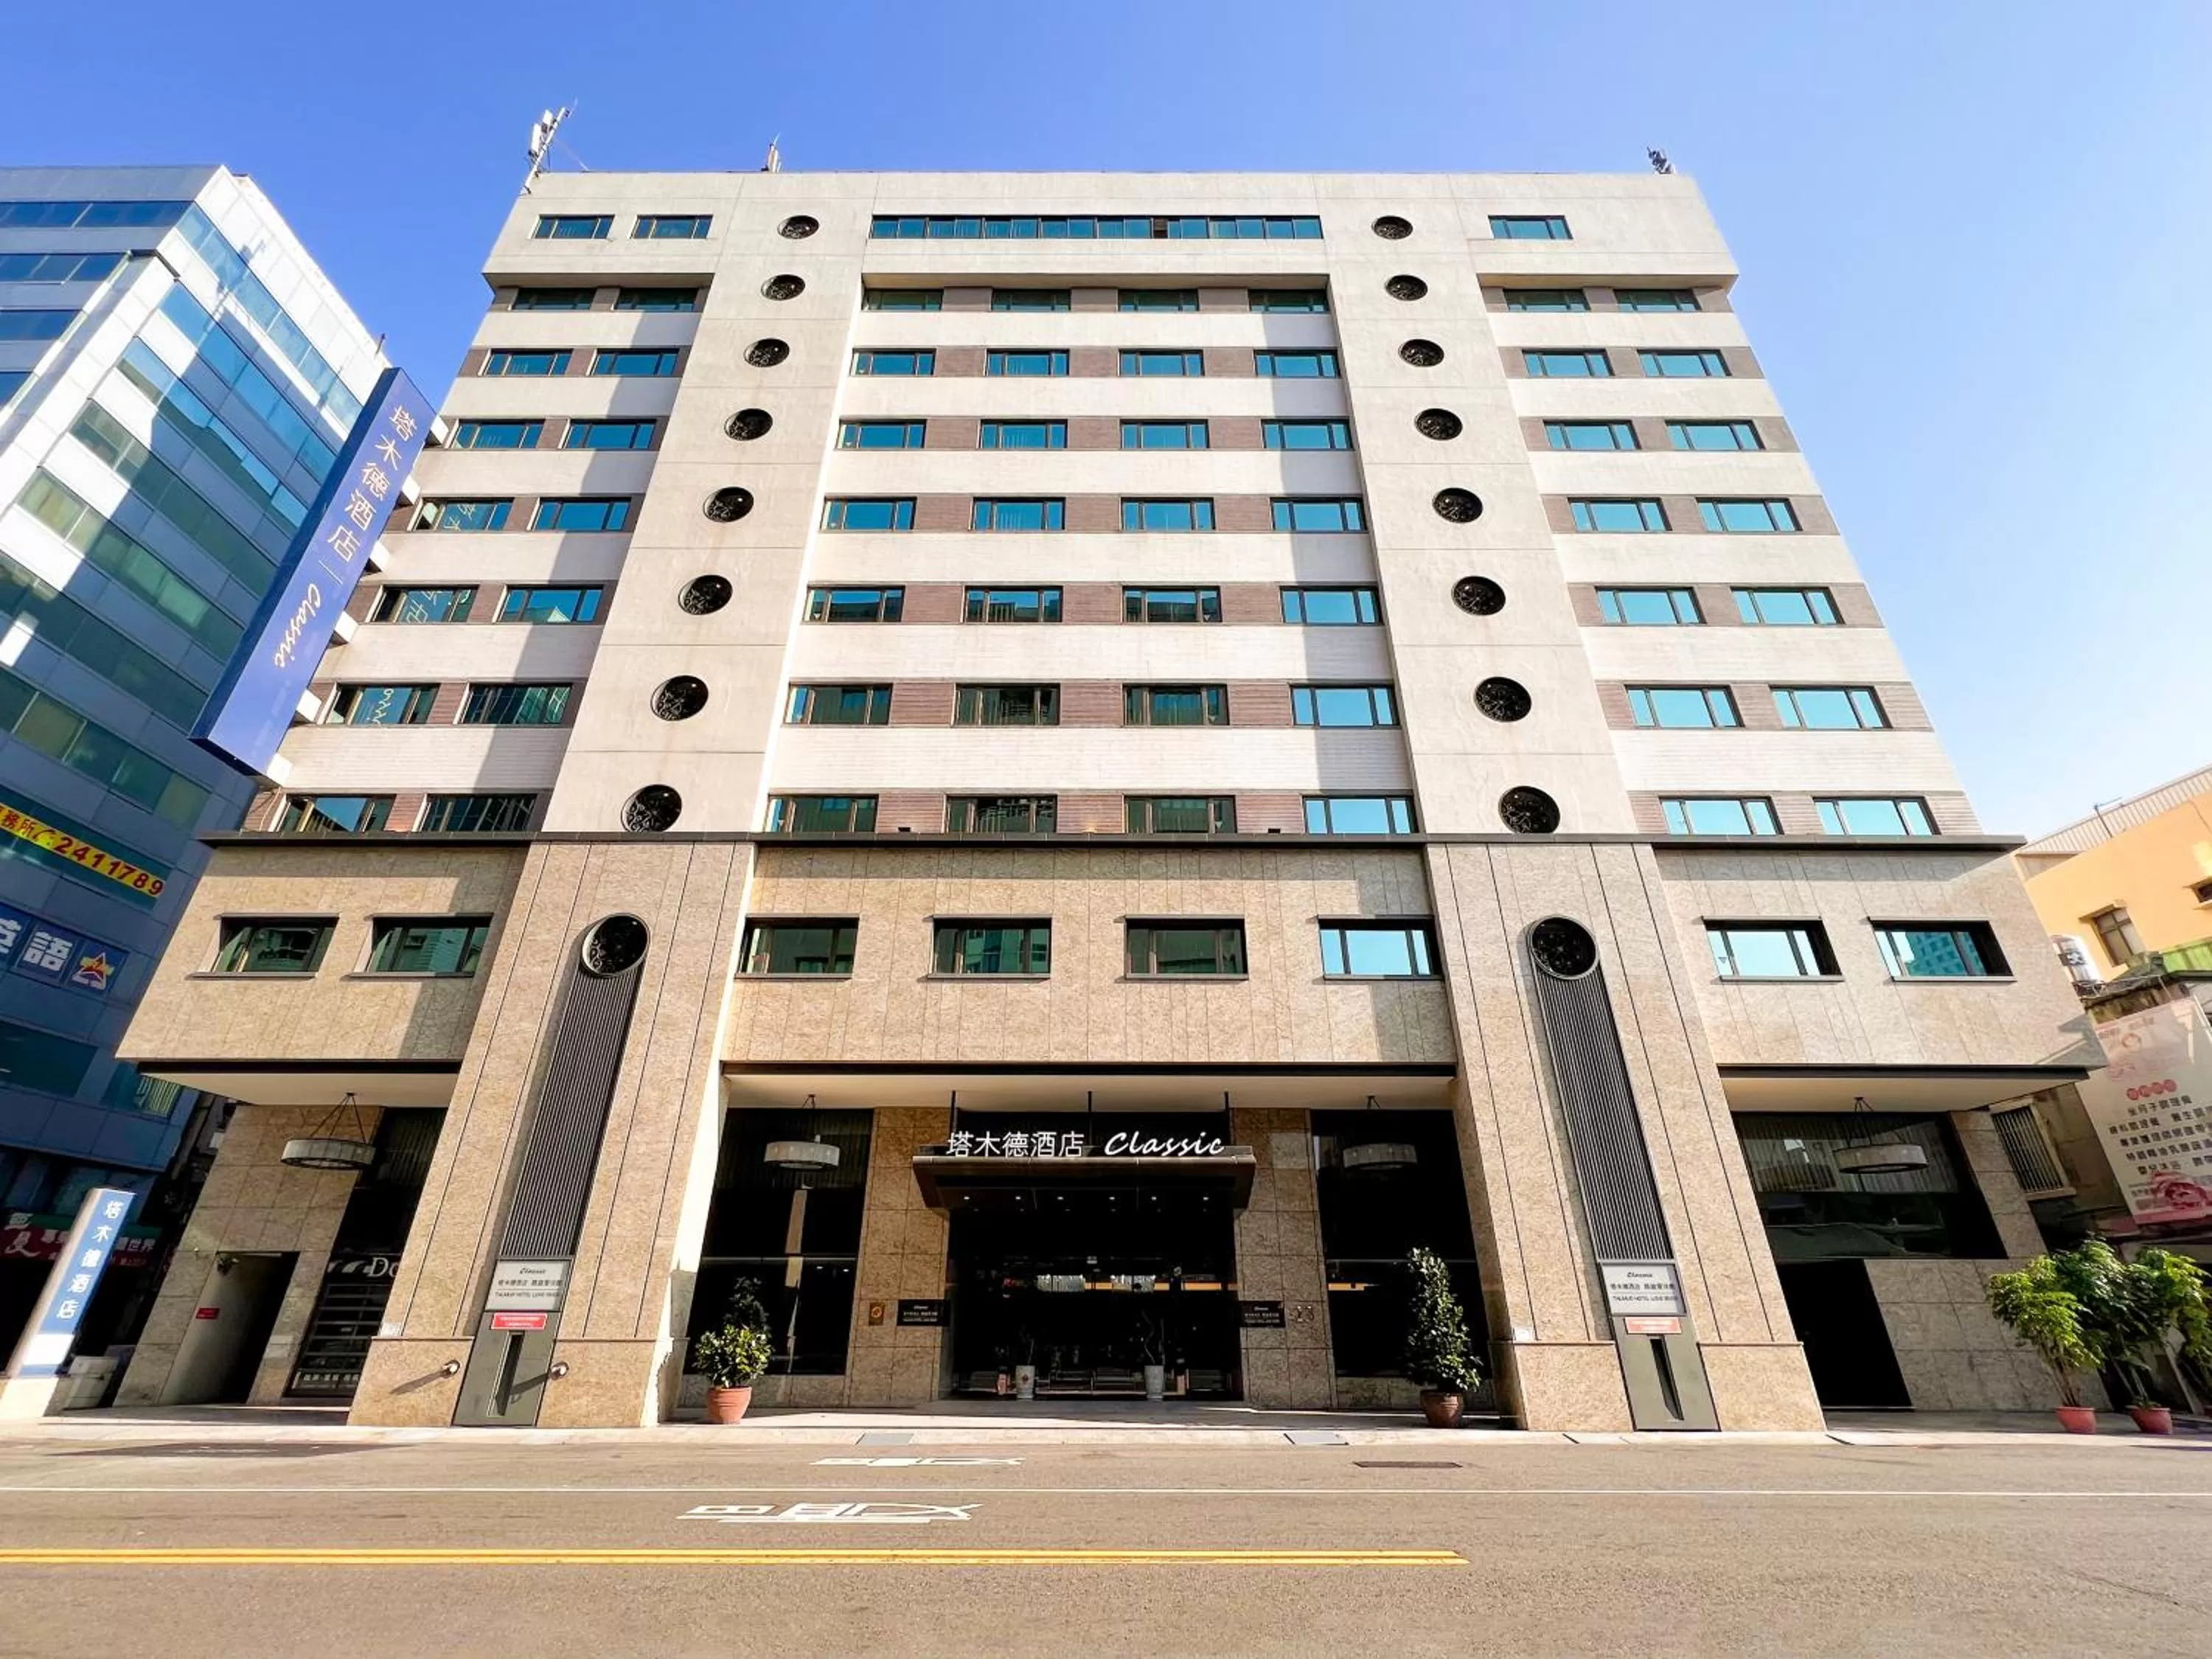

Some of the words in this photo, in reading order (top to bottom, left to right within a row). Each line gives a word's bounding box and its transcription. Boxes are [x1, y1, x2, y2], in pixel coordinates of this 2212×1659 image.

[327, 406, 417, 563] 塔木德酒店
[274, 583, 321, 667] Classic
[0, 807, 36, 838] 務所
[54, 837, 164, 896] 2411789
[946, 1130, 1085, 1158] 塔木德酒店
[1105, 1131, 1225, 1156] Classic
[57, 1200, 125, 1320] 塔木德酒店
